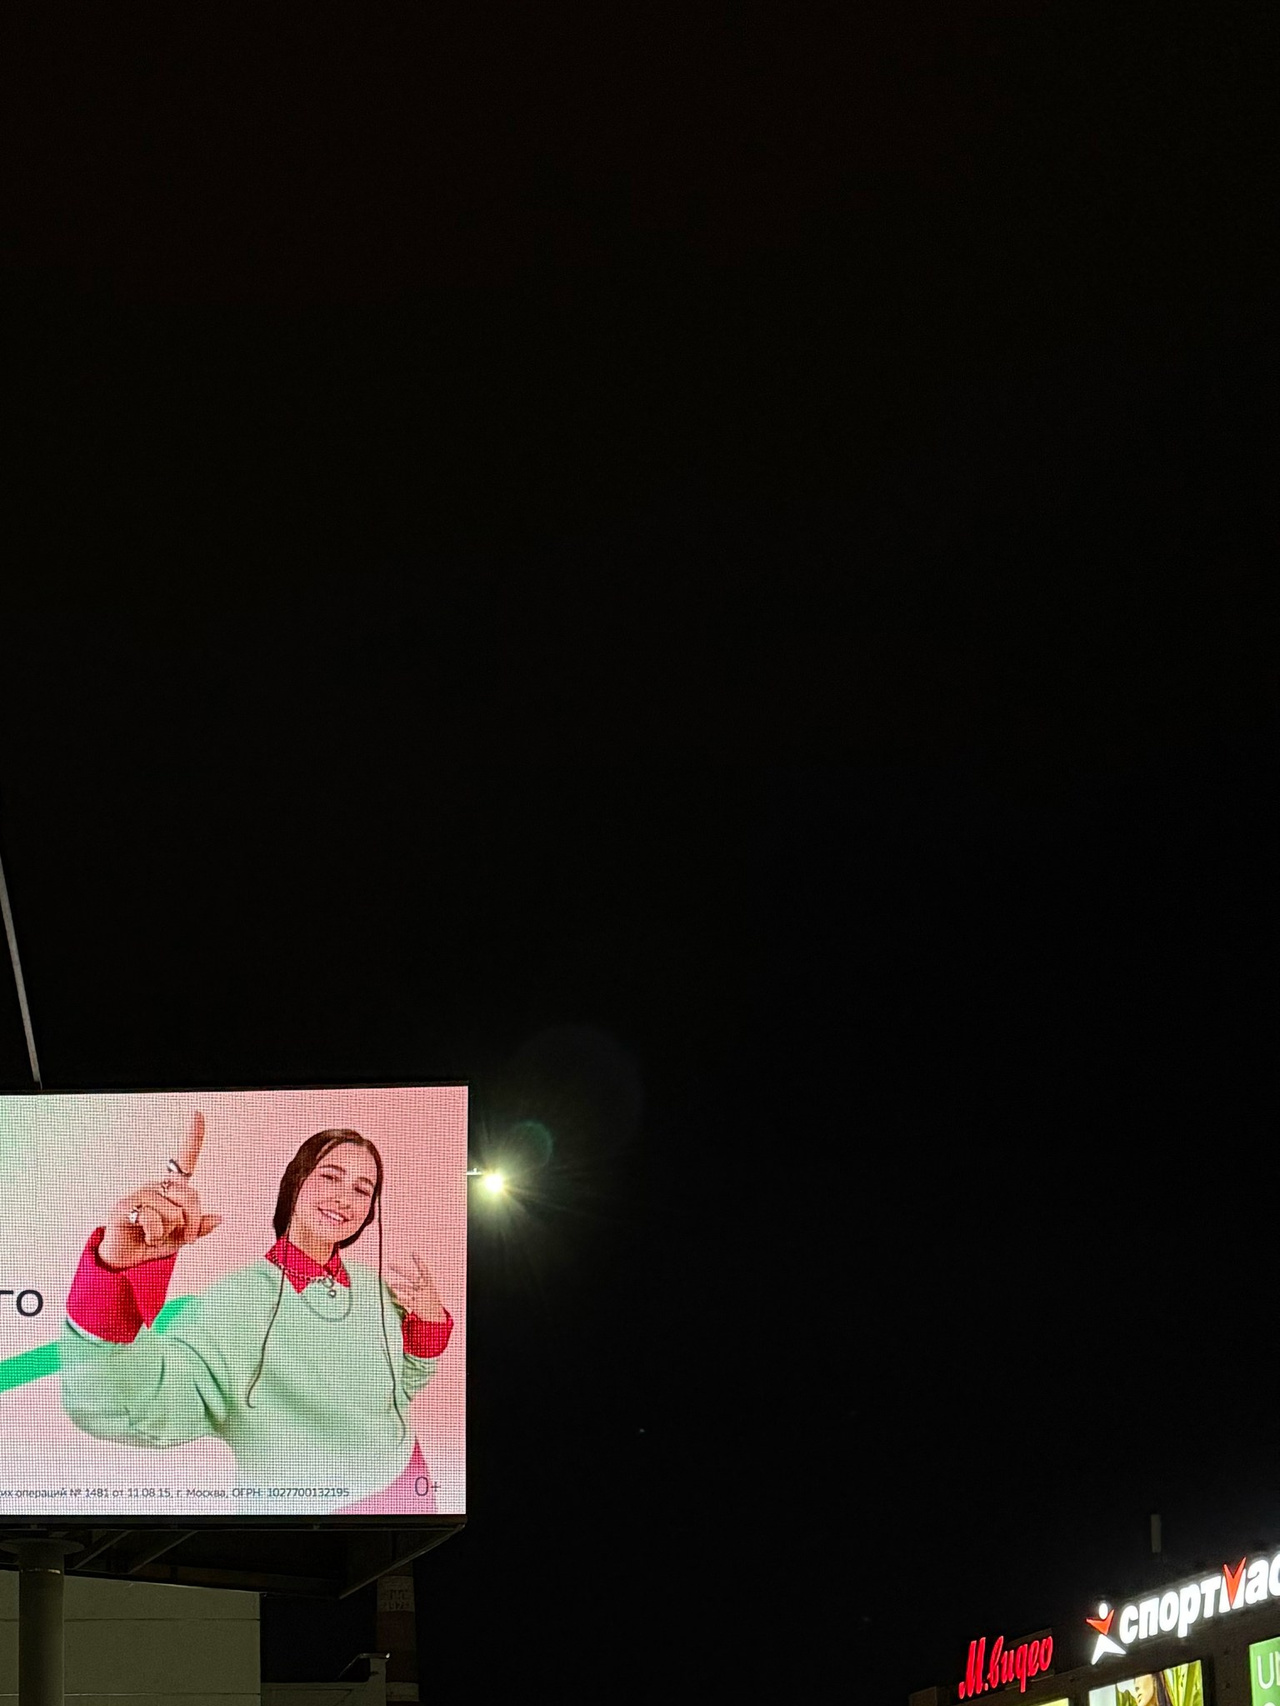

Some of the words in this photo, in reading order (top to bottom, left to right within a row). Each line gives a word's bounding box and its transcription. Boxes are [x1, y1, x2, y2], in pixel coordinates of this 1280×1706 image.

[15, 1487, 68, 1500] операций
[84, 1487, 109, 1499] 1481
[112, 1489, 125, 1498] от
[267, 1487, 350, 1498] 1027700132195
[414, 1476, 442, 1497] 0+
